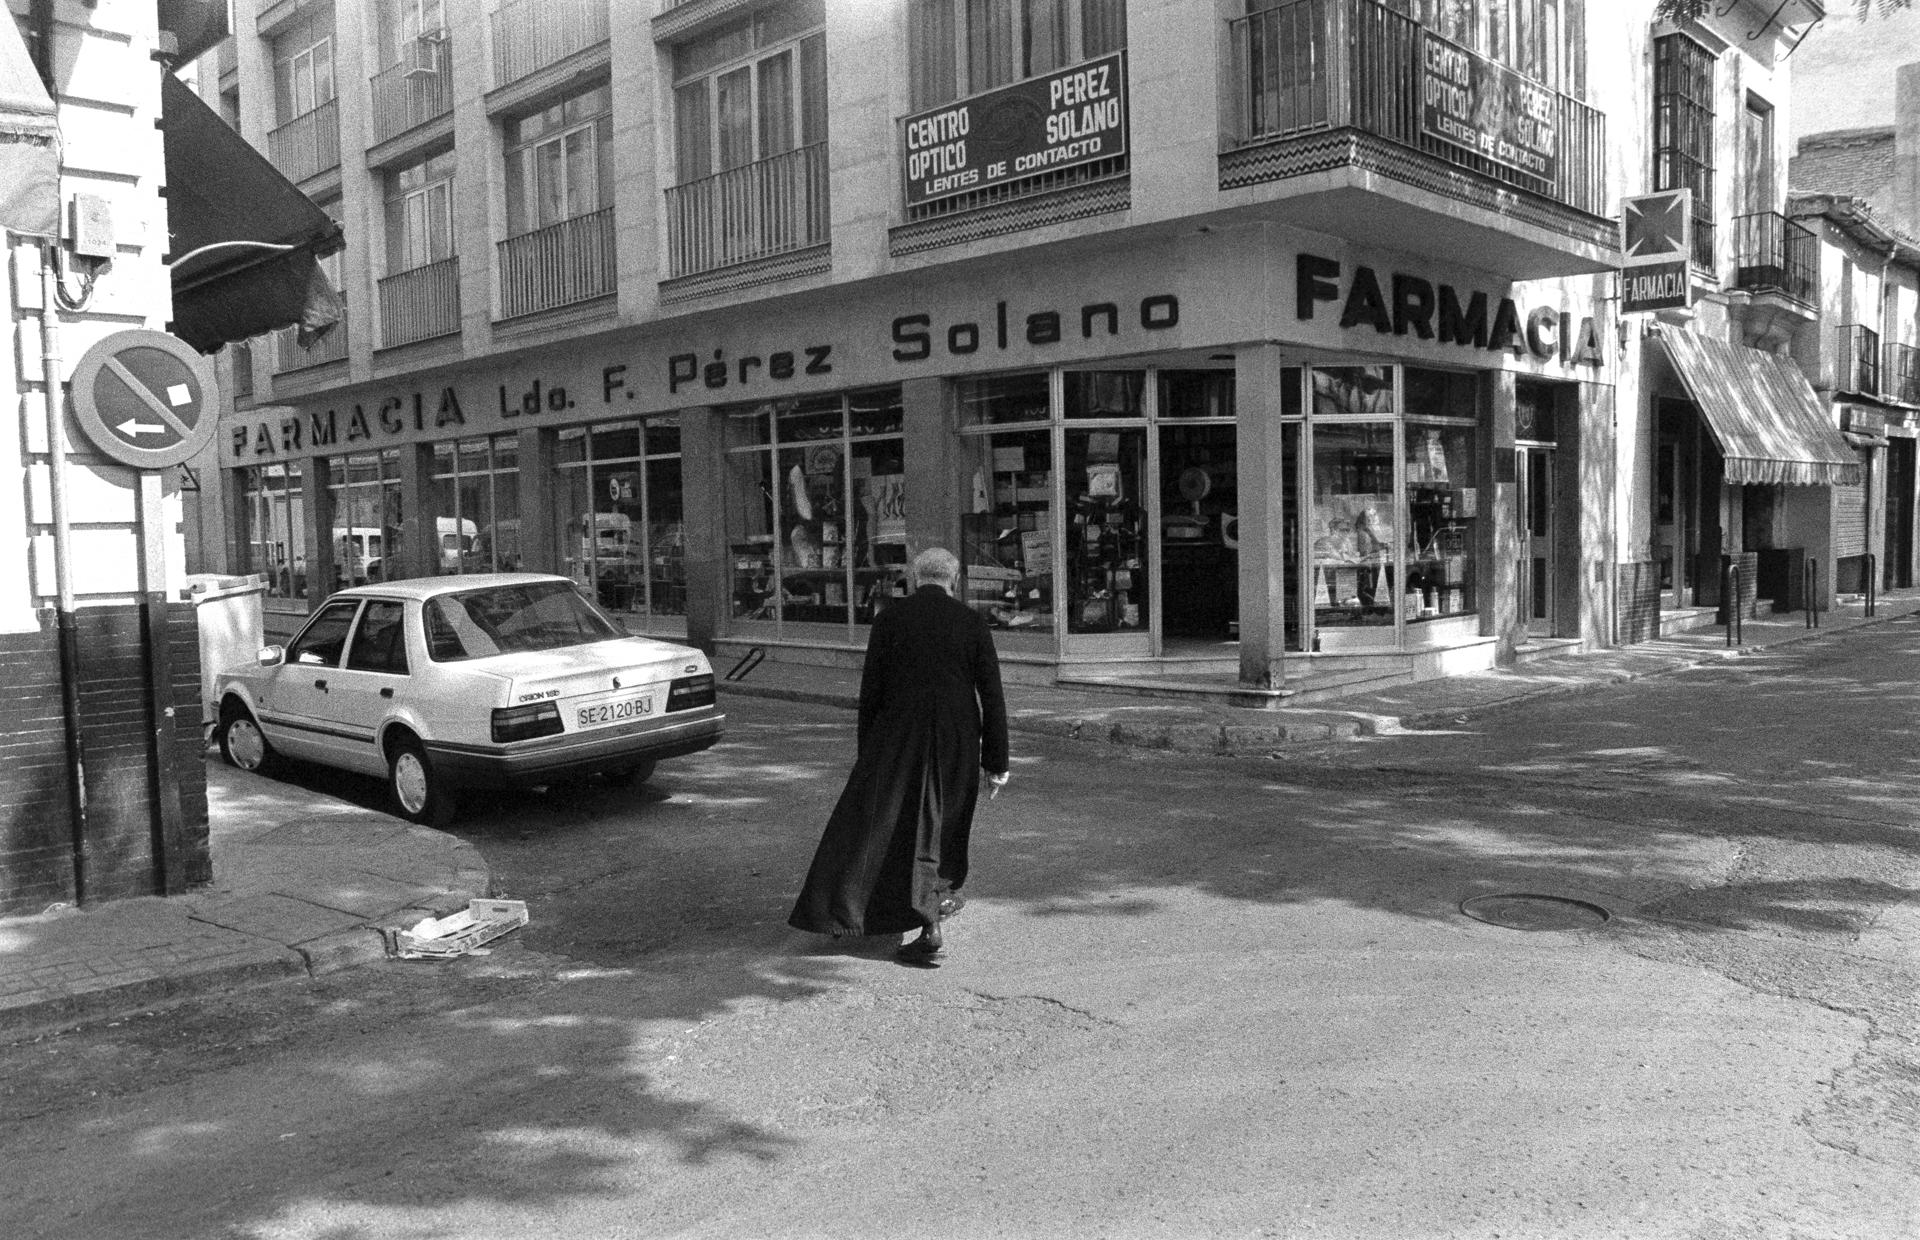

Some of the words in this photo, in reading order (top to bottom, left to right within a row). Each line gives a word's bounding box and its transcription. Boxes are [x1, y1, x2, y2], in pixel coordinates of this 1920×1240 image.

[1425, 38, 1469, 87] CENTRO
[1050, 65, 1110, 110] PEREZ
[1425, 74, 1466, 120] OPTICO
[1519, 84, 1551, 125] PEREZ
[908, 107, 969, 150] CENTRO
[1046, 97, 1119, 145] SOLANO
[1437, 114, 1476, 144] LENTES
[1480, 132, 1494, 151] DE
[1500, 140, 1546, 173] CONTACTO
[1518, 115, 1554, 158] SOLANO
[909, 140, 967, 181] OPTICO
[925, 169, 979, 195] LENTES
[987, 161, 1007, 179] DE
[1015, 137, 1101, 172] CONTACTO
[1623, 272, 1685, 303] FARMACIA
[1296, 254, 1605, 368] FARMACIA
[231, 386, 466, 457] FARMACIA
[500, 379, 575, 419] Ldo.
[603, 364, 634, 402] F.
[669, 343, 833, 394] Pérez
[892, 294, 1180, 362] Solano
